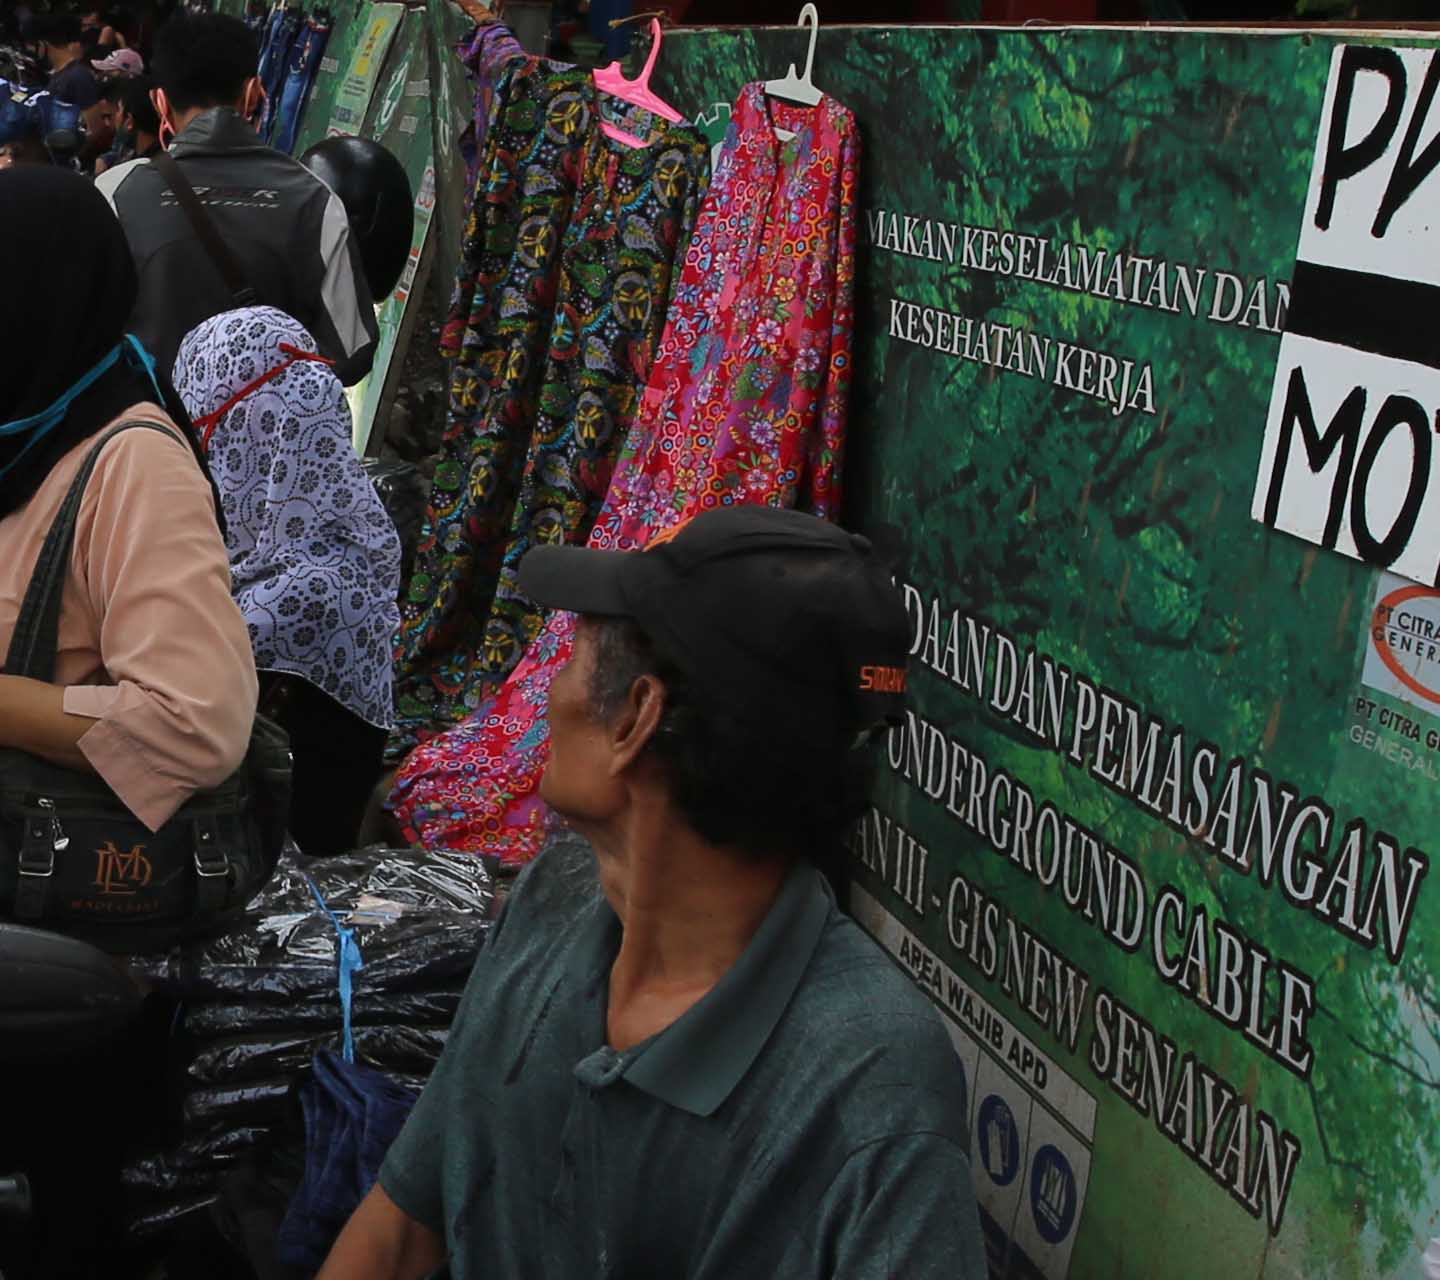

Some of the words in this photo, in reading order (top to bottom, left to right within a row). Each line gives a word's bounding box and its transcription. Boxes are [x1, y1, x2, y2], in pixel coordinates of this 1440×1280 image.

[961, 225, 1206, 320] KESELAMATAN
[888, 298, 1050, 380] KESEHATAN
[1053, 342, 1157, 417] KERJA
[1376, 602, 1395, 627] PT
[891, 575, 989, 698] DAAN
[991, 632, 1069, 748] DAN
[1069, 679, 1423, 957] PEMASANGAN
[1350, 723, 1439, 781] GENERAL
[1355, 697, 1375, 720] PT
[1378, 708, 1421, 743] CITRA
[887, 710, 1146, 948] UNDERGROUND
[1153, 894, 1313, 1071] CABLE
[892, 825, 929, 914] III
[946, 876, 998, 977] GIS
[1000, 914, 1089, 1053] NEW
[1090, 992, 1298, 1230] SENAYAN
[899, 933, 945, 997] AREA
[948, 979, 1005, 1052] WAJIB
[1007, 1042, 1048, 1090] APD
